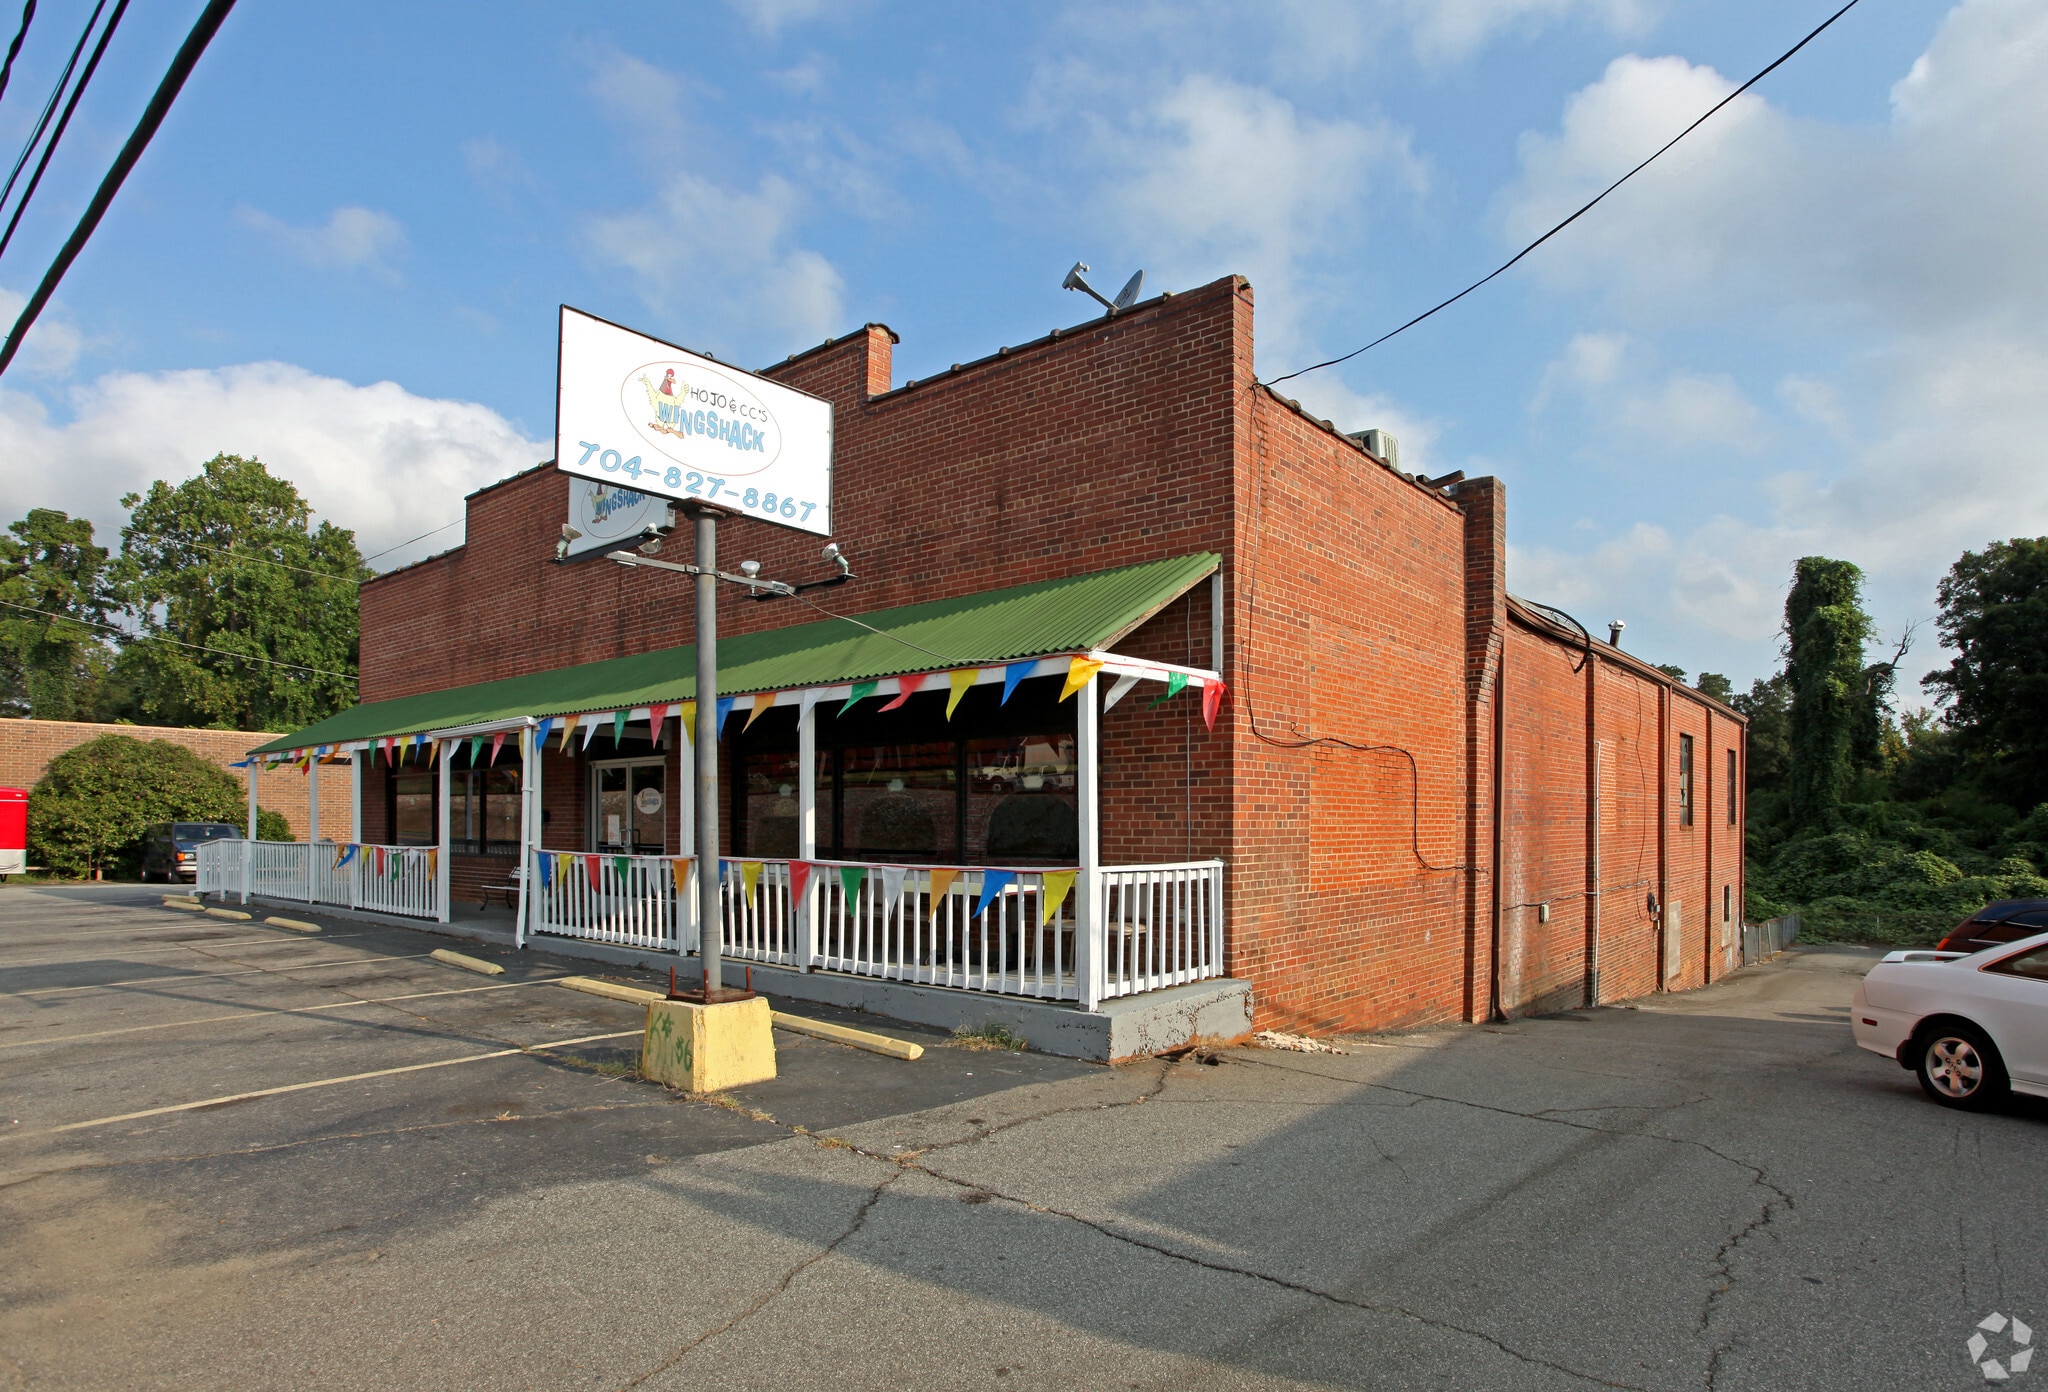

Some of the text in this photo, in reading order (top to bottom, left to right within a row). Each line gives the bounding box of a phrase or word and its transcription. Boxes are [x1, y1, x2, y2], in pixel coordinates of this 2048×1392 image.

[690, 387, 727, 408] HOJO
[739, 404, 768, 422] CC'S
[578, 441, 817, 522] 704-827-8867
